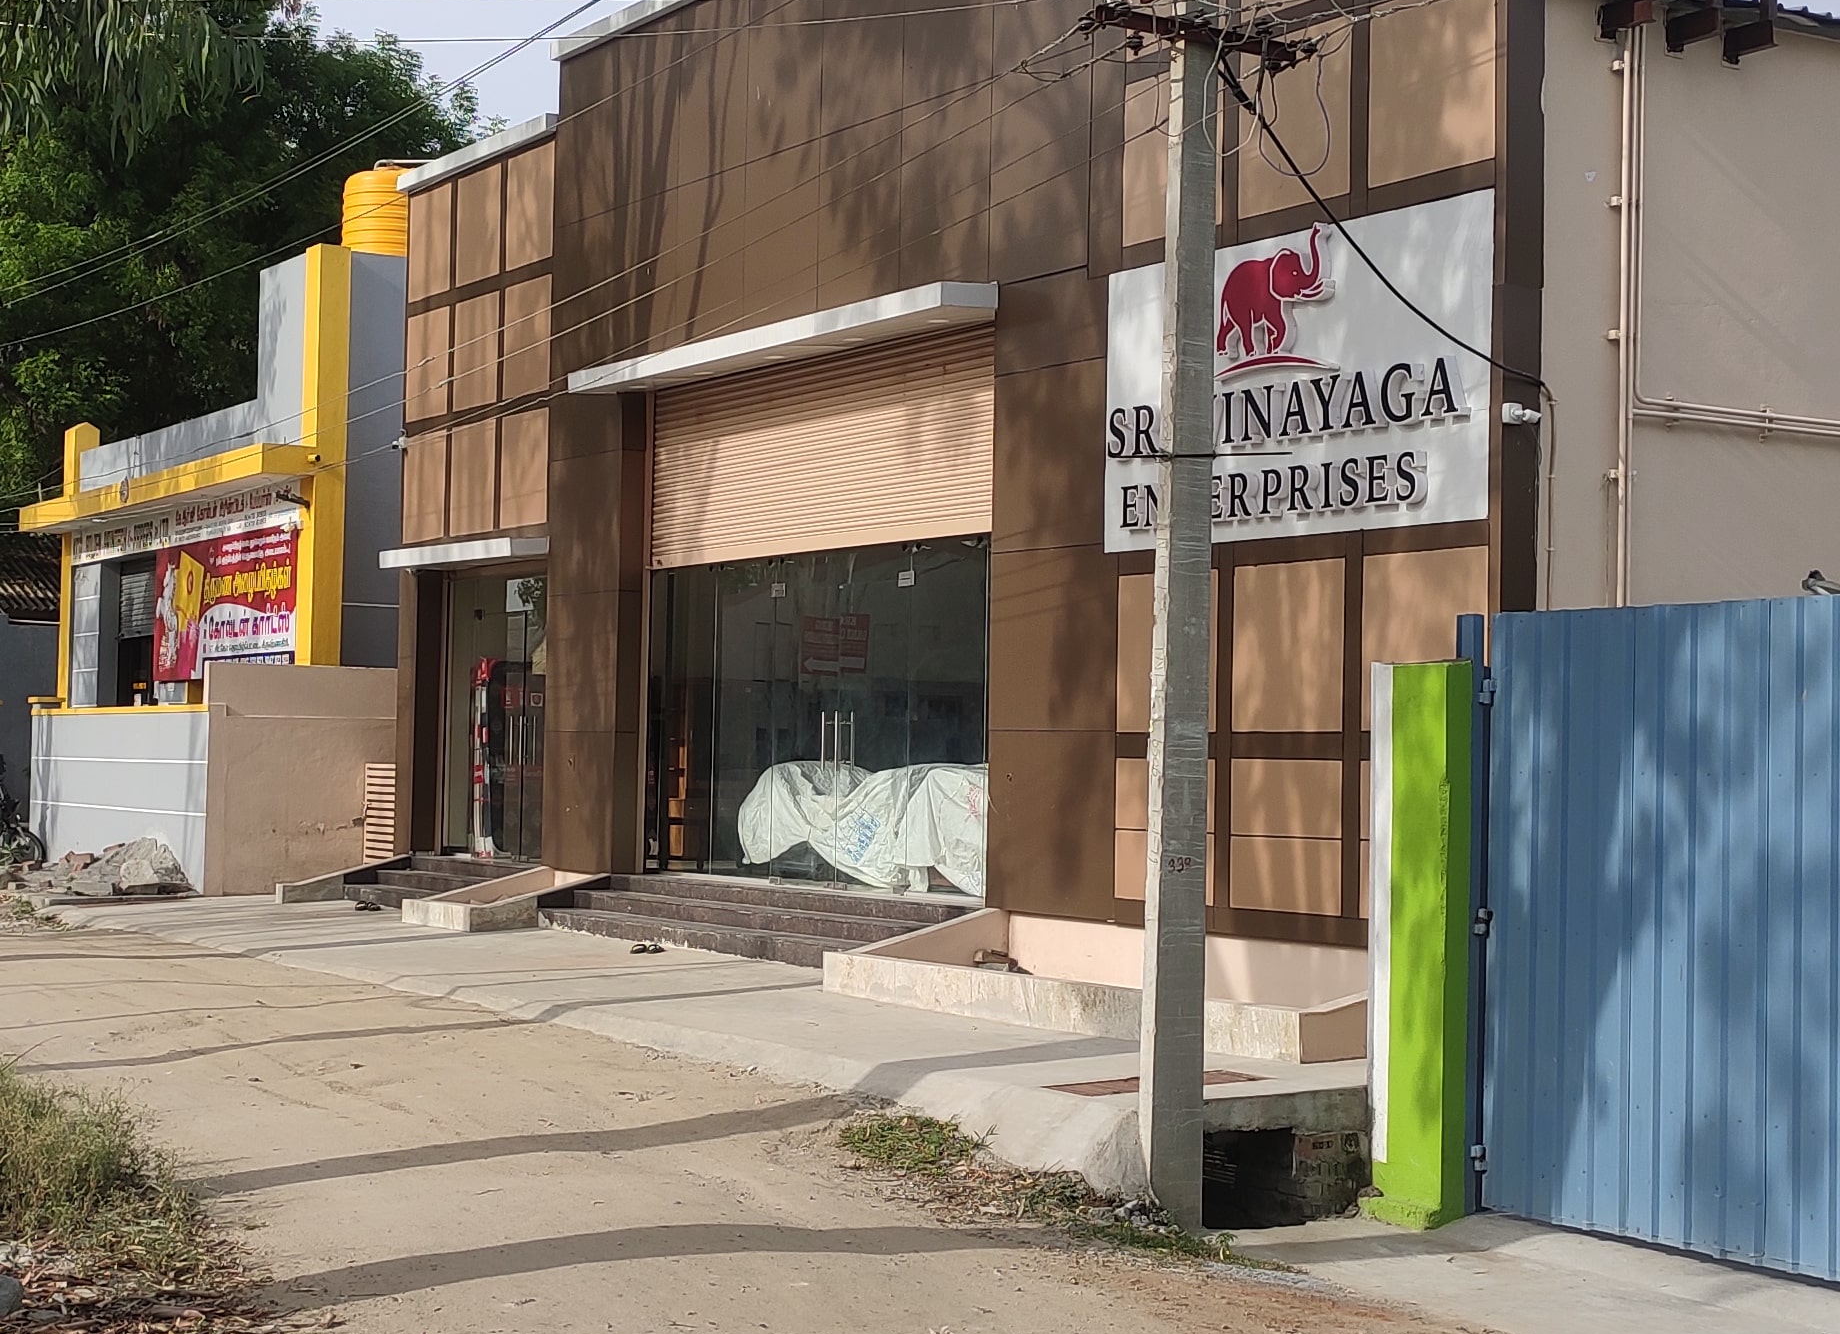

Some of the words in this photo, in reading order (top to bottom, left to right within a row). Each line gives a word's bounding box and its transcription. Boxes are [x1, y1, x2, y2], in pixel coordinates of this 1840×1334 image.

[1107, 404, 1159, 459] SR
[1212, 356, 1459, 445] INAYAGA
[1119, 451, 1417, 529] ENERPRISES
